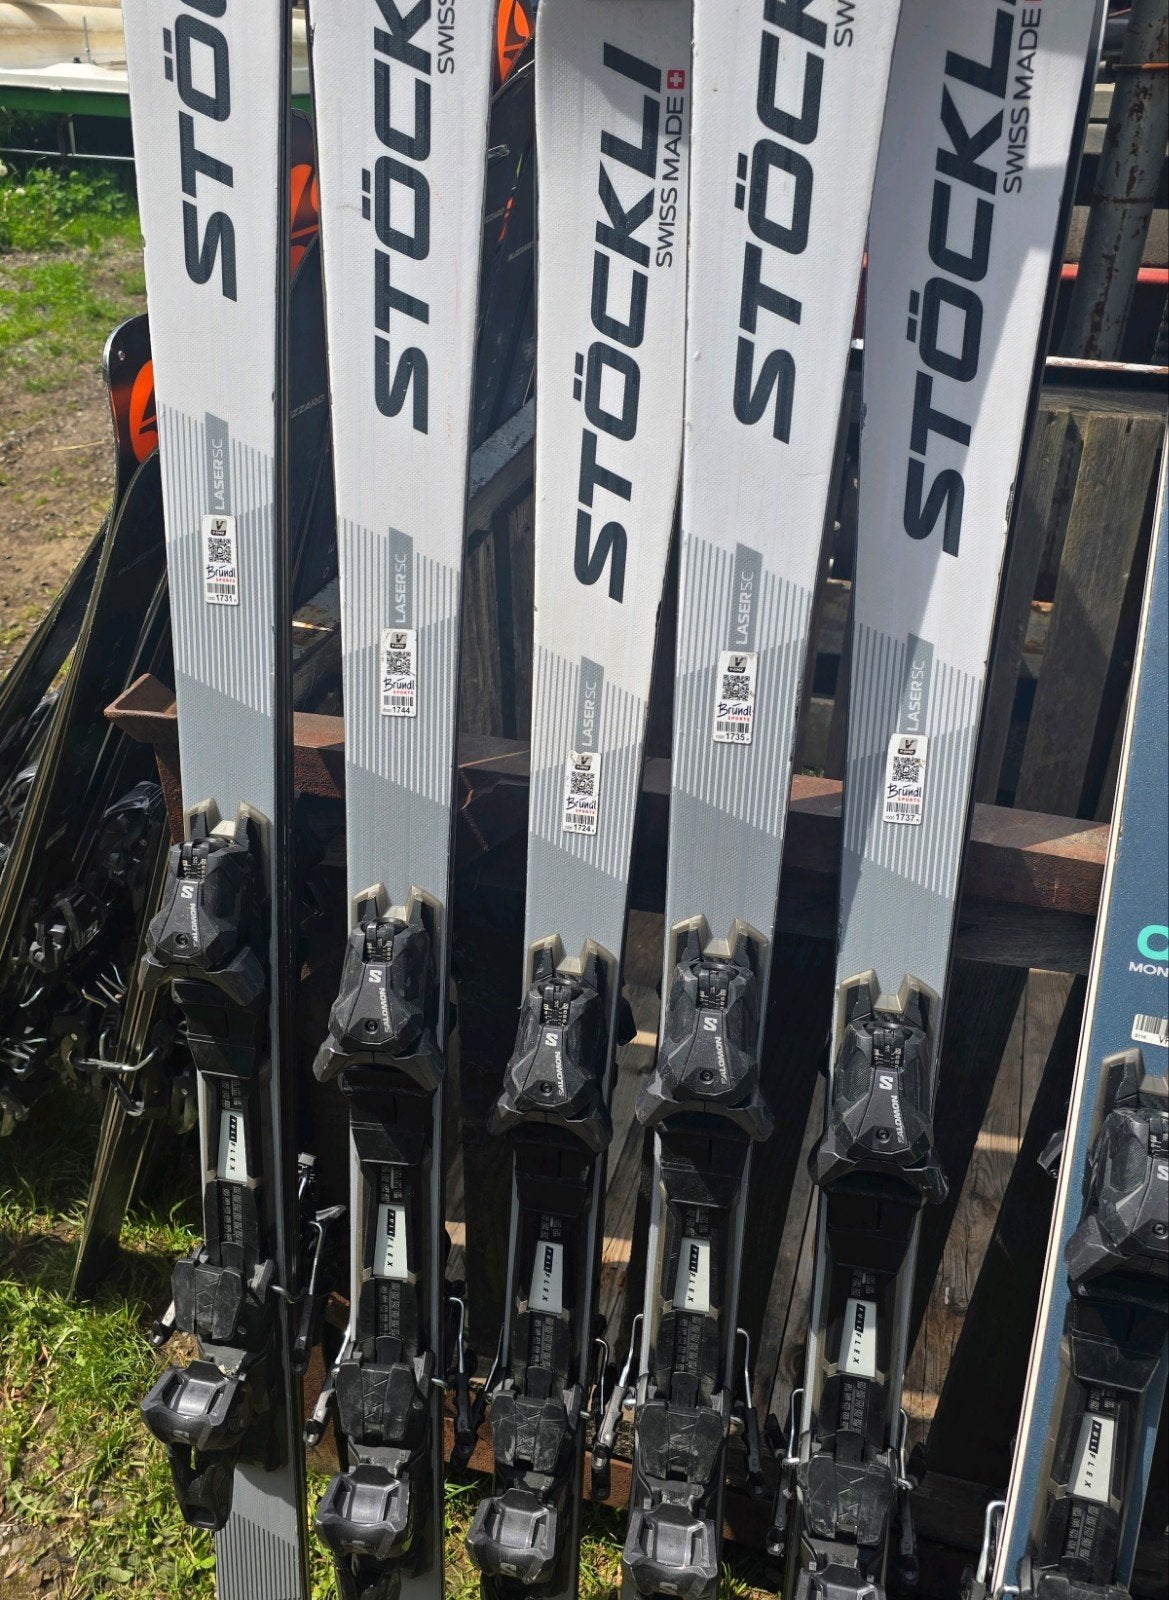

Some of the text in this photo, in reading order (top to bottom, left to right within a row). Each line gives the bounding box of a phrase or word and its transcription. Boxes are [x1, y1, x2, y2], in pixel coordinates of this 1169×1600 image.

[438, 0, 455, 74] SWIS
[1003, 8, 1042, 194] SWISS MADE
[656, 96, 684, 268] SWISS MADE
[903, 0, 1017, 557] STÖCKL
[573, 42, 661, 602] STÖCKLI
[216, 594, 232, 602] 1731
[392, 706, 410, 714] 1744
[726, 732, 745, 741] 1735
[574, 824, 591, 832] 1724
[896, 813, 915, 821] 1737
[379, 987, 392, 1033] SALOMON
[555, 1051, 564, 1097] SALOMON
[890, 1095, 904, 1143] SALOMON
